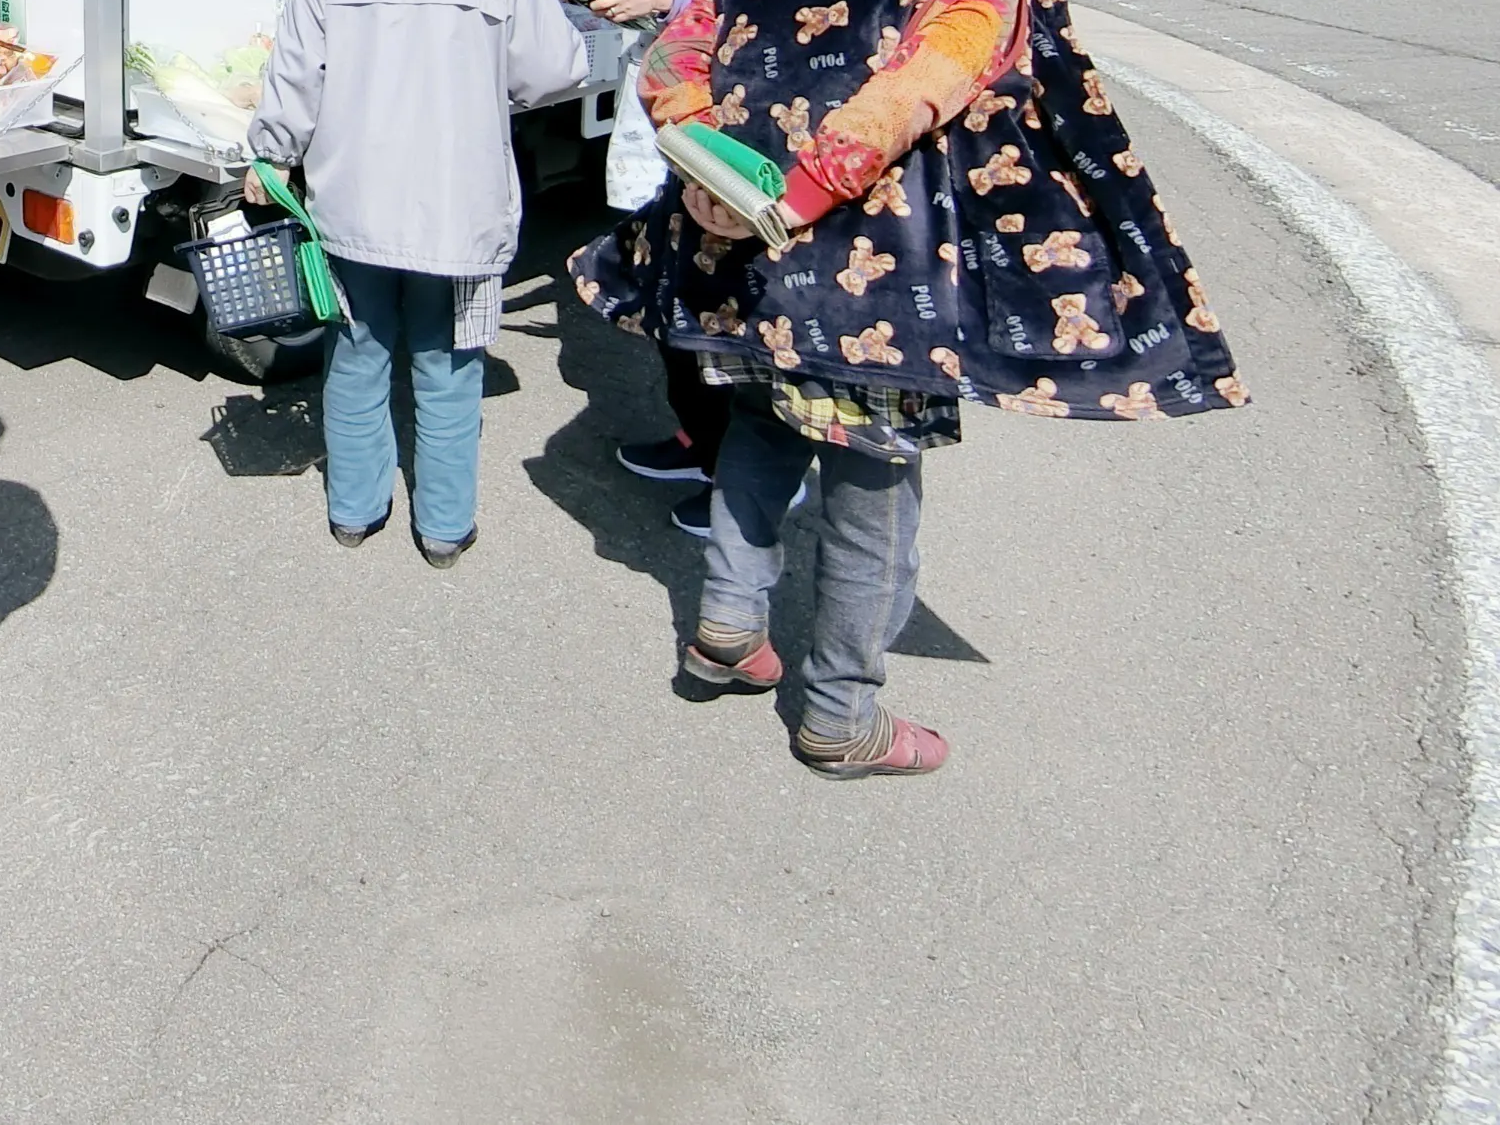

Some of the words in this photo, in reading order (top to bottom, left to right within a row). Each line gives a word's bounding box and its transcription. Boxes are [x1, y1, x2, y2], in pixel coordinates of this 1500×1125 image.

[809, 52, 846, 70] POLO
[1032, 32, 1059, 58] POLO
[763, 46, 779, 79] POLO
[1072, 150, 1106, 180] POLO
[1118, 219, 1152, 255] POLO
[783, 269, 817, 289] POLO
[911, 284, 937, 321] POLO
[804, 318, 830, 353] POLO
[1006, 315, 1034, 353] POLO
[1128, 322, 1171, 355] POLO
[1166, 370, 1204, 405] POLO
